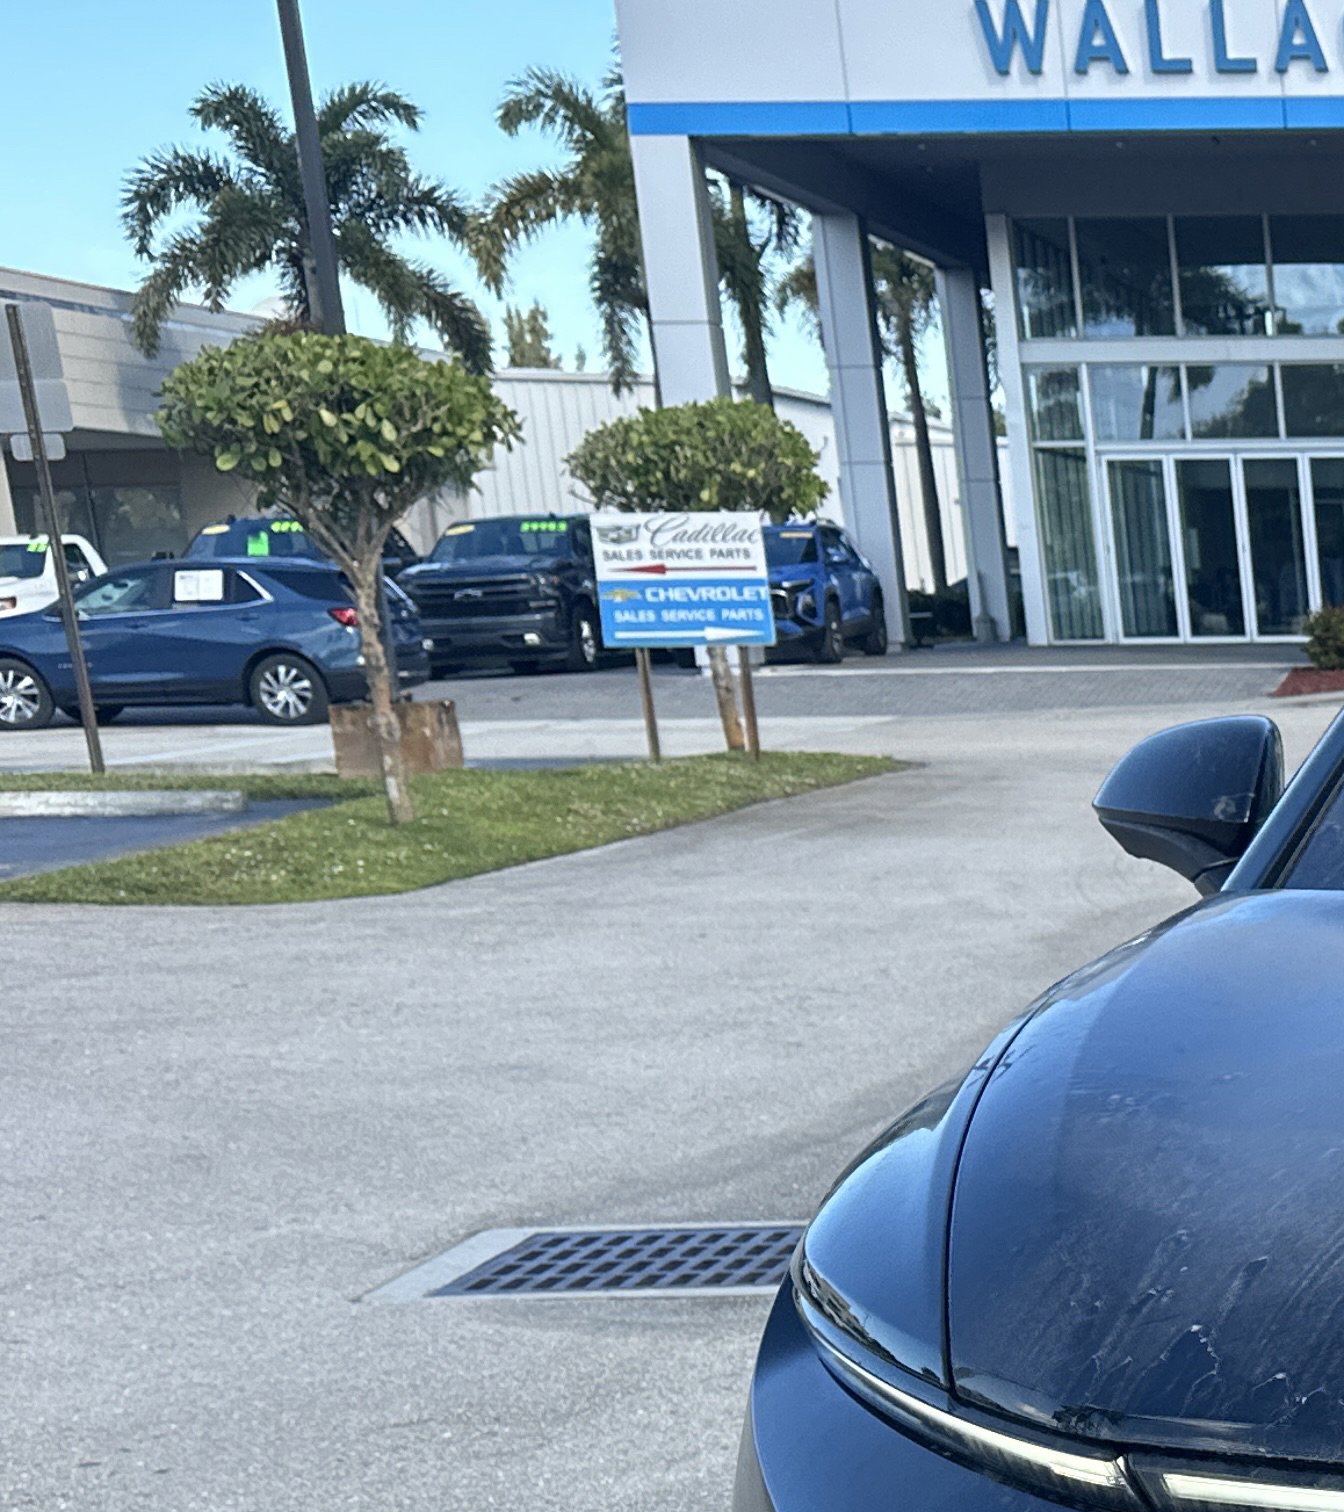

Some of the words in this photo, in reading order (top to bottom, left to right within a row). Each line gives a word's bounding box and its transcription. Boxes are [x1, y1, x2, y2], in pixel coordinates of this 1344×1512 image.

[643, 514, 759, 547] Cadillac
[603, 549, 643, 561] SALES
[650, 548, 703, 560] SERVICE
[710, 548, 751, 560] PARTS
[645, 585, 767, 602] CHEVROLET
[613, 609, 656, 623] SALES
[661, 608, 716, 622] SERVICE
[721, 608, 764, 621] PARTS
